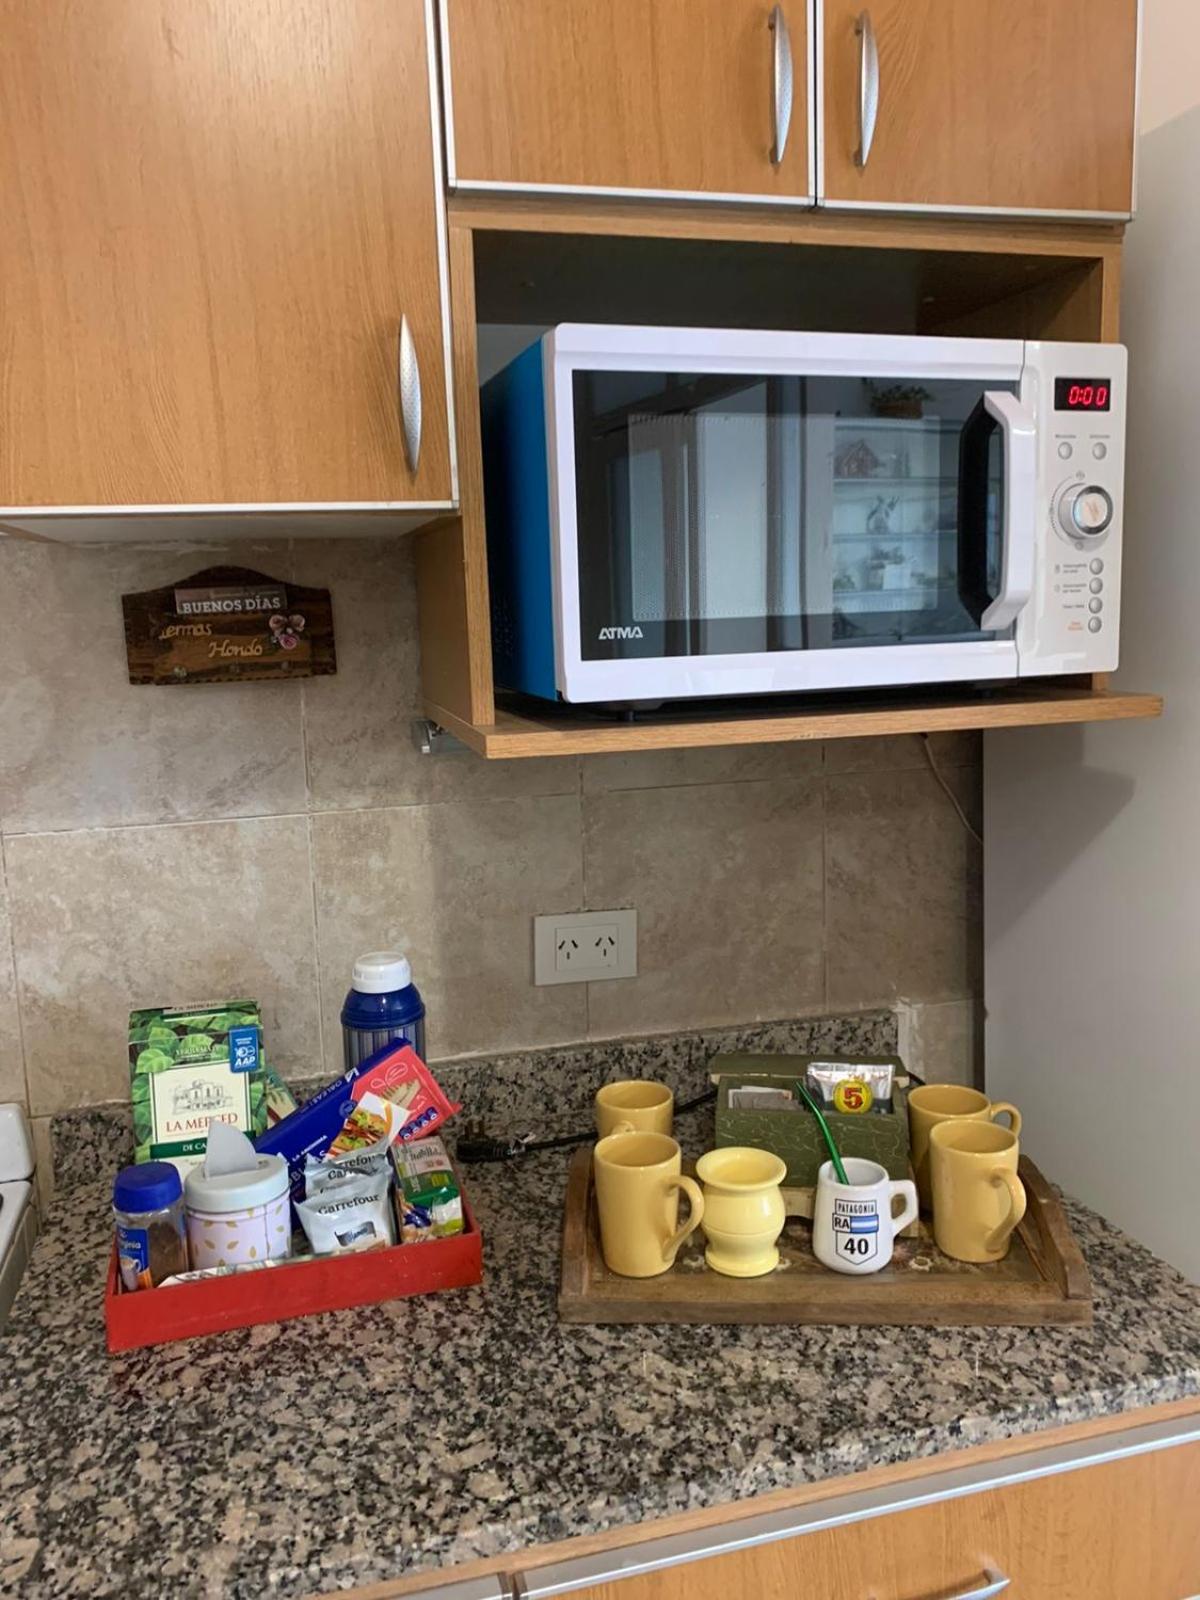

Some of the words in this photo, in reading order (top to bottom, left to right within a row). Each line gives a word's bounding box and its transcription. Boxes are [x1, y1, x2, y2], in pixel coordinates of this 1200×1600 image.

[1068, 385, 1107, 406] 0:00
[182, 600, 241, 614] BUENOS
[245, 595, 281, 610] DÍAS
[158, 624, 213, 640] ermas
[598, 626, 644, 640] ATMA
[208, 638, 263, 658] Hondo
[235, 1056, 256, 1068] AAP
[843, 1087, 864, 1110] 5
[166, 1120, 183, 1133] LA
[318, 1194, 380, 1214] Carrefour
[838, 1203, 874, 1214] PATAGONIA
[834, 1217, 850, 1230] RA
[844, 1237, 869, 1256] 40
